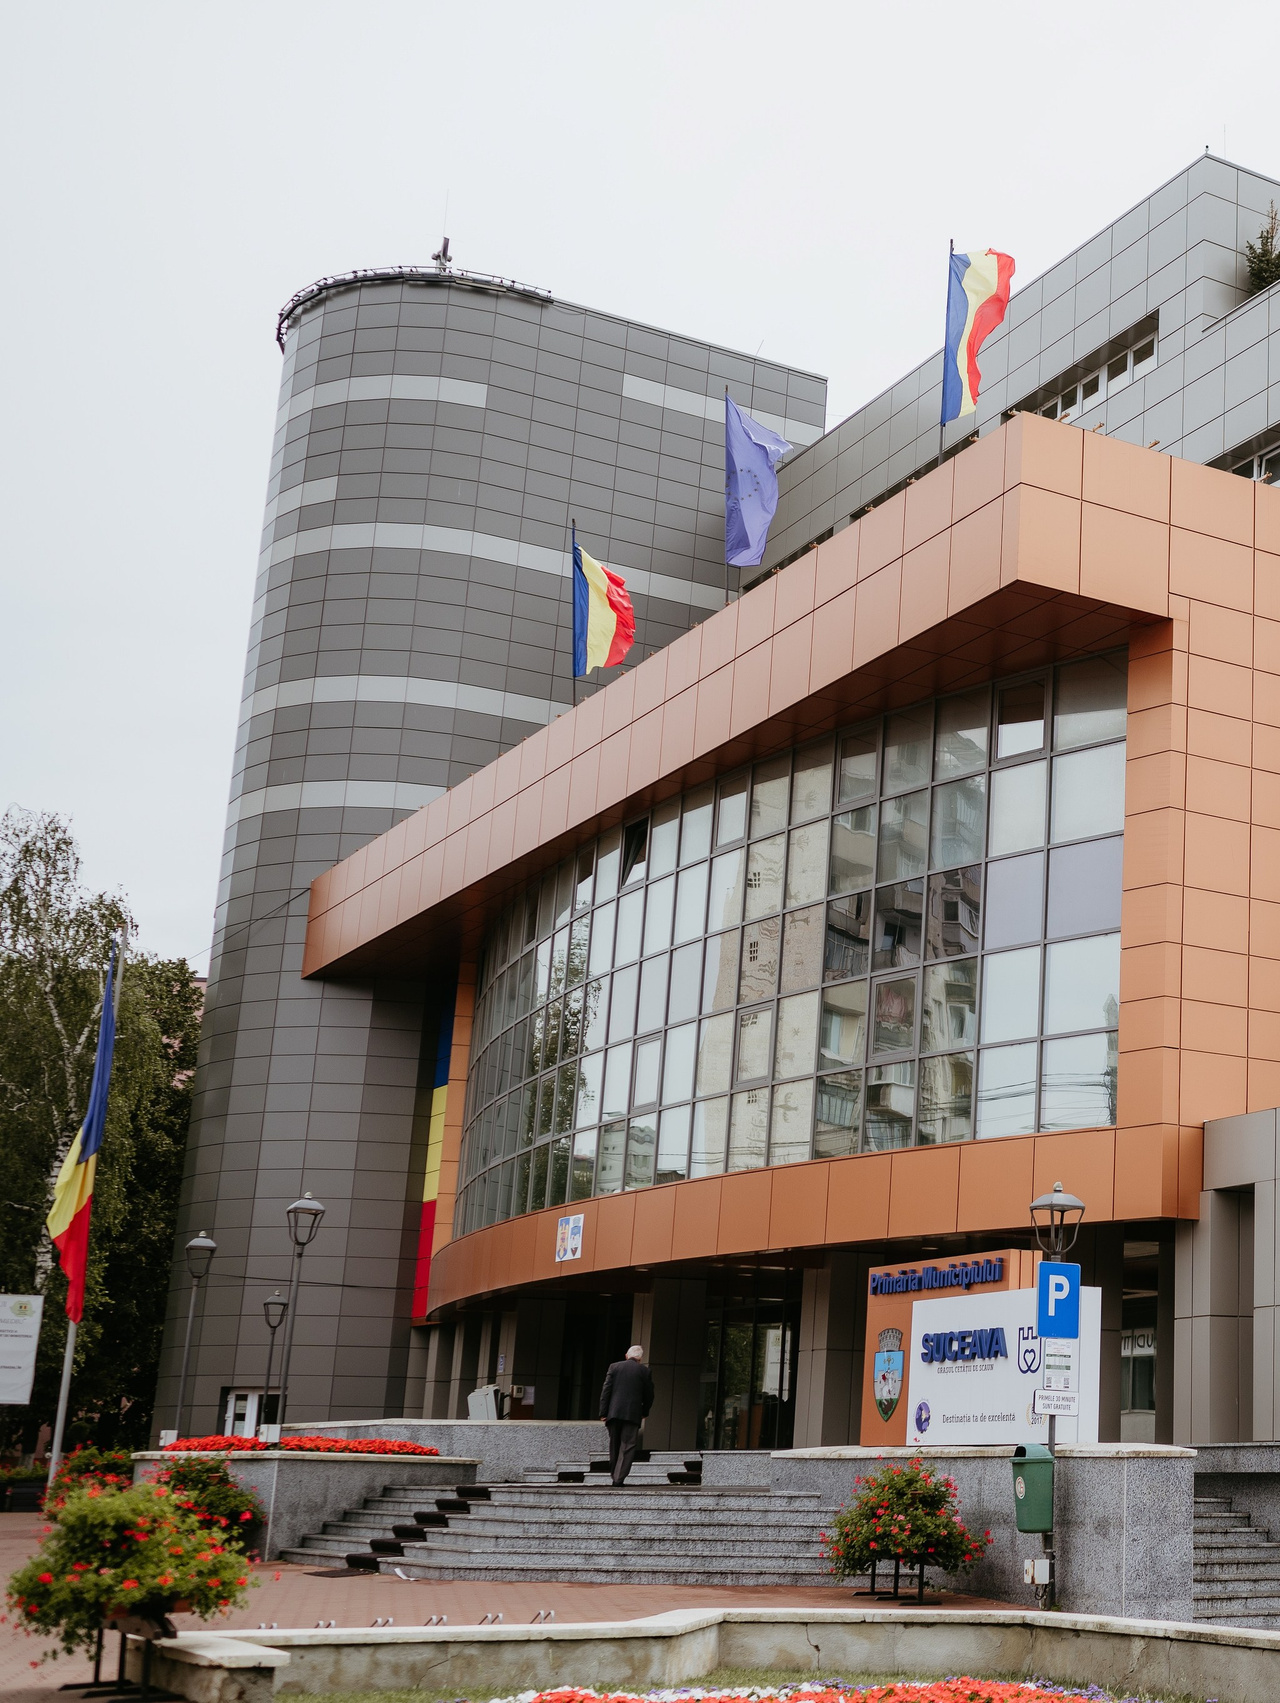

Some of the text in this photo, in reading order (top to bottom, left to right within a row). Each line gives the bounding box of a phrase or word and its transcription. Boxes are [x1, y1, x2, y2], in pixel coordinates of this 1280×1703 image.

[921, 1257, 1004, 1290] Municipiului
[1048, 1275, 1070, 1316] P
[921, 1327, 1008, 1363] SUCEAVA
[973, 1364, 978, 1372] DE
[1039, 1394, 1055, 1402] PRIMELE
[1043, 1402, 1052, 1410] SUNT
[972, 1414, 979, 1423] ta
[980, 1412, 987, 1422] de
[1031, 1417, 1042, 1425] 2017
